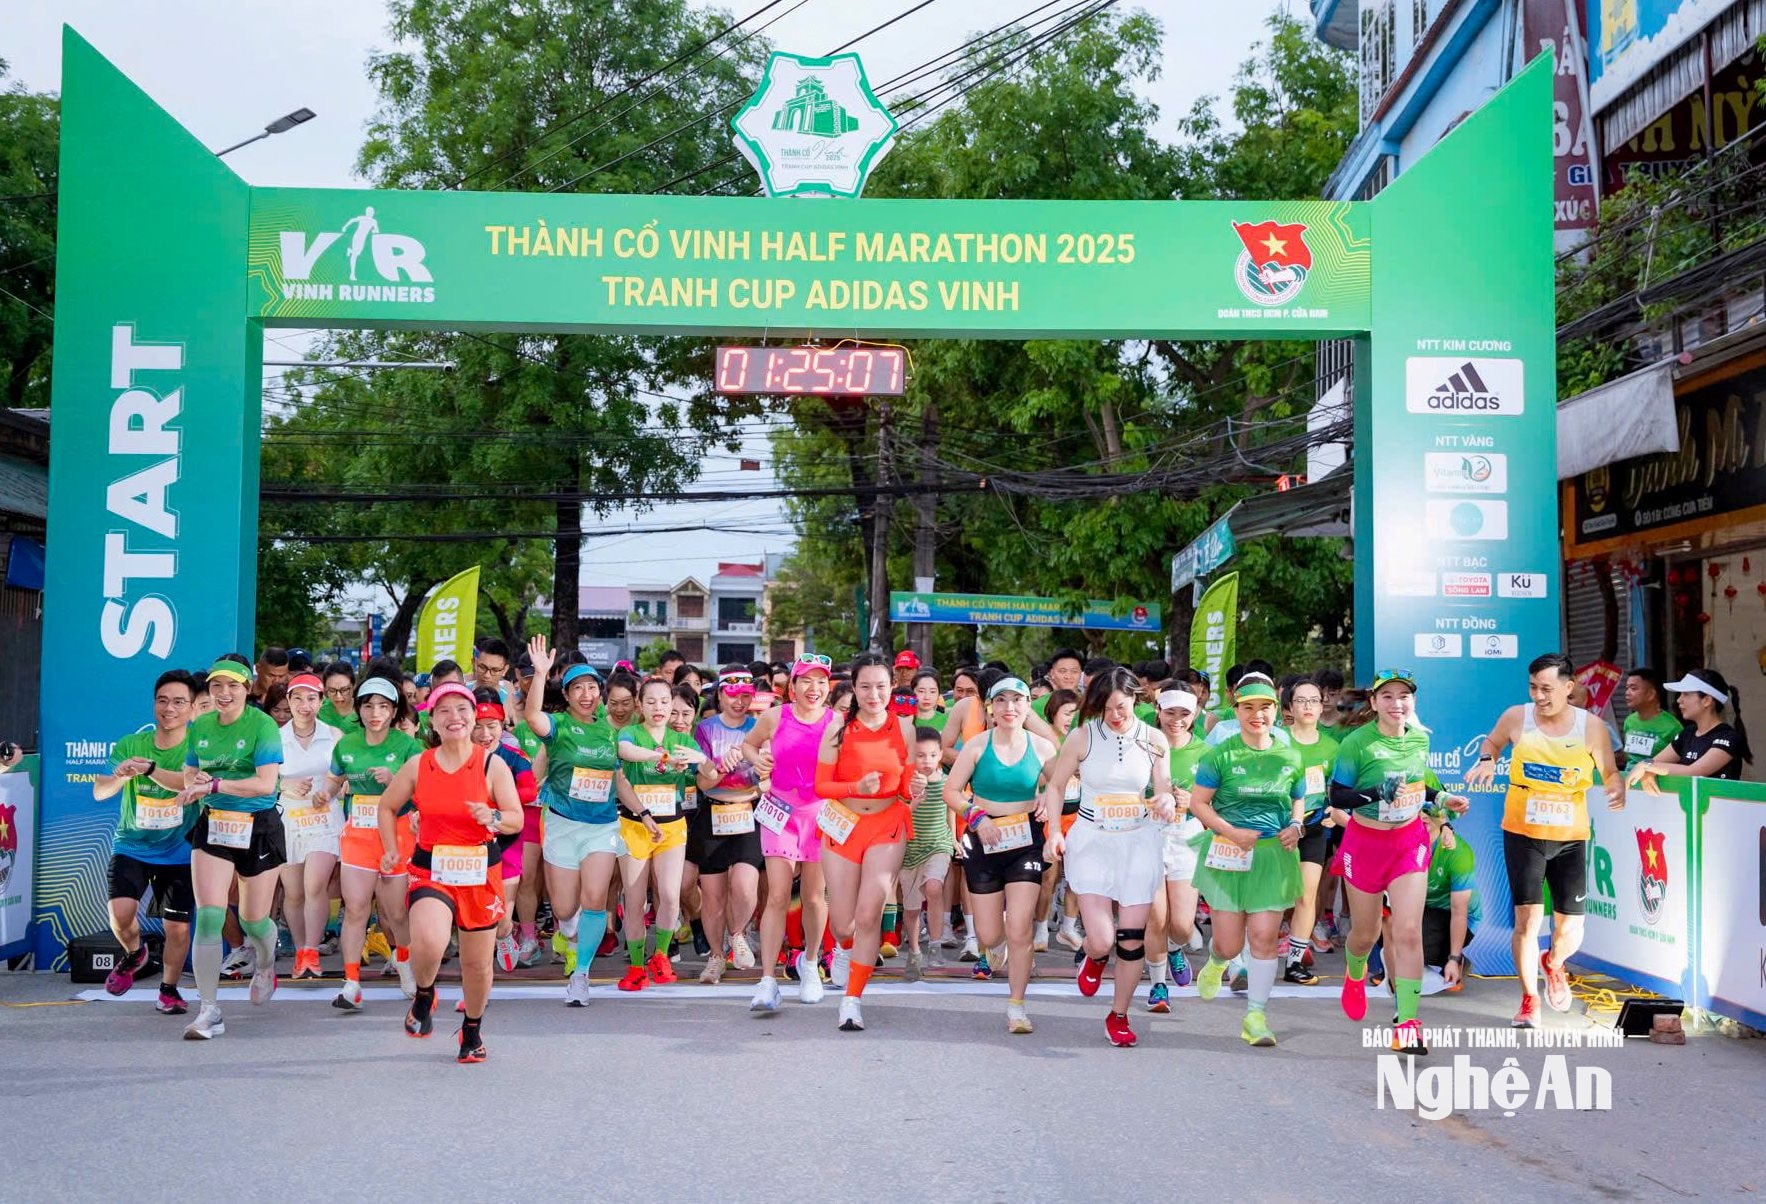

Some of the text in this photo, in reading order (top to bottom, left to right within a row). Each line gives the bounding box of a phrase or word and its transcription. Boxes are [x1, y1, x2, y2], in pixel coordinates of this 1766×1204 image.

[485, 219, 1135, 265] THÀNH CỔ VINH HALF MARATHON 2025
[282, 284, 436, 303] VINH RUNNERS
[602, 275, 1019, 311] TRANH CUP ADIDAS VINH
[1417, 340, 1512, 351] NTT KIM CƯƠNG
[719, 349, 900, 392] 01:25:07
[1428, 392, 1500, 410] adidas
[1436, 434, 1494, 447] NTT VÀNG
[101, 321, 186, 660] START
[1463, 557, 1488, 570] BẠC
[970, 612, 1002, 622] TRANH
[1004, 613, 1023, 622] CUP
[1025, 614, 1060, 624] ADIDAS
[1436, 615, 1497, 630] NTT ĐỒNG
[65, 739, 107, 758] THÀNH
[1445, 746, 1461, 768] CỔ
[578, 778, 609, 789] 10147
[1444, 783, 1506, 793] CUP ADIDAS
[640, 794, 672, 805] 10148
[1393, 793, 1421, 809] 0020
[141, 806, 178, 818] 10160
[760, 800, 785, 822] 21010
[1101, 806, 1140, 819] 10080
[1533, 801, 1569, 814] 10163
[294, 814, 328, 828] 10093
[716, 812, 749, 825] 10070
[822, 803, 850, 831] 10018
[213, 820, 247, 834] 10107
[1213, 844, 1248, 861] 10092
[438, 858, 482, 871] 10050
[95, 956, 111, 968] 08
